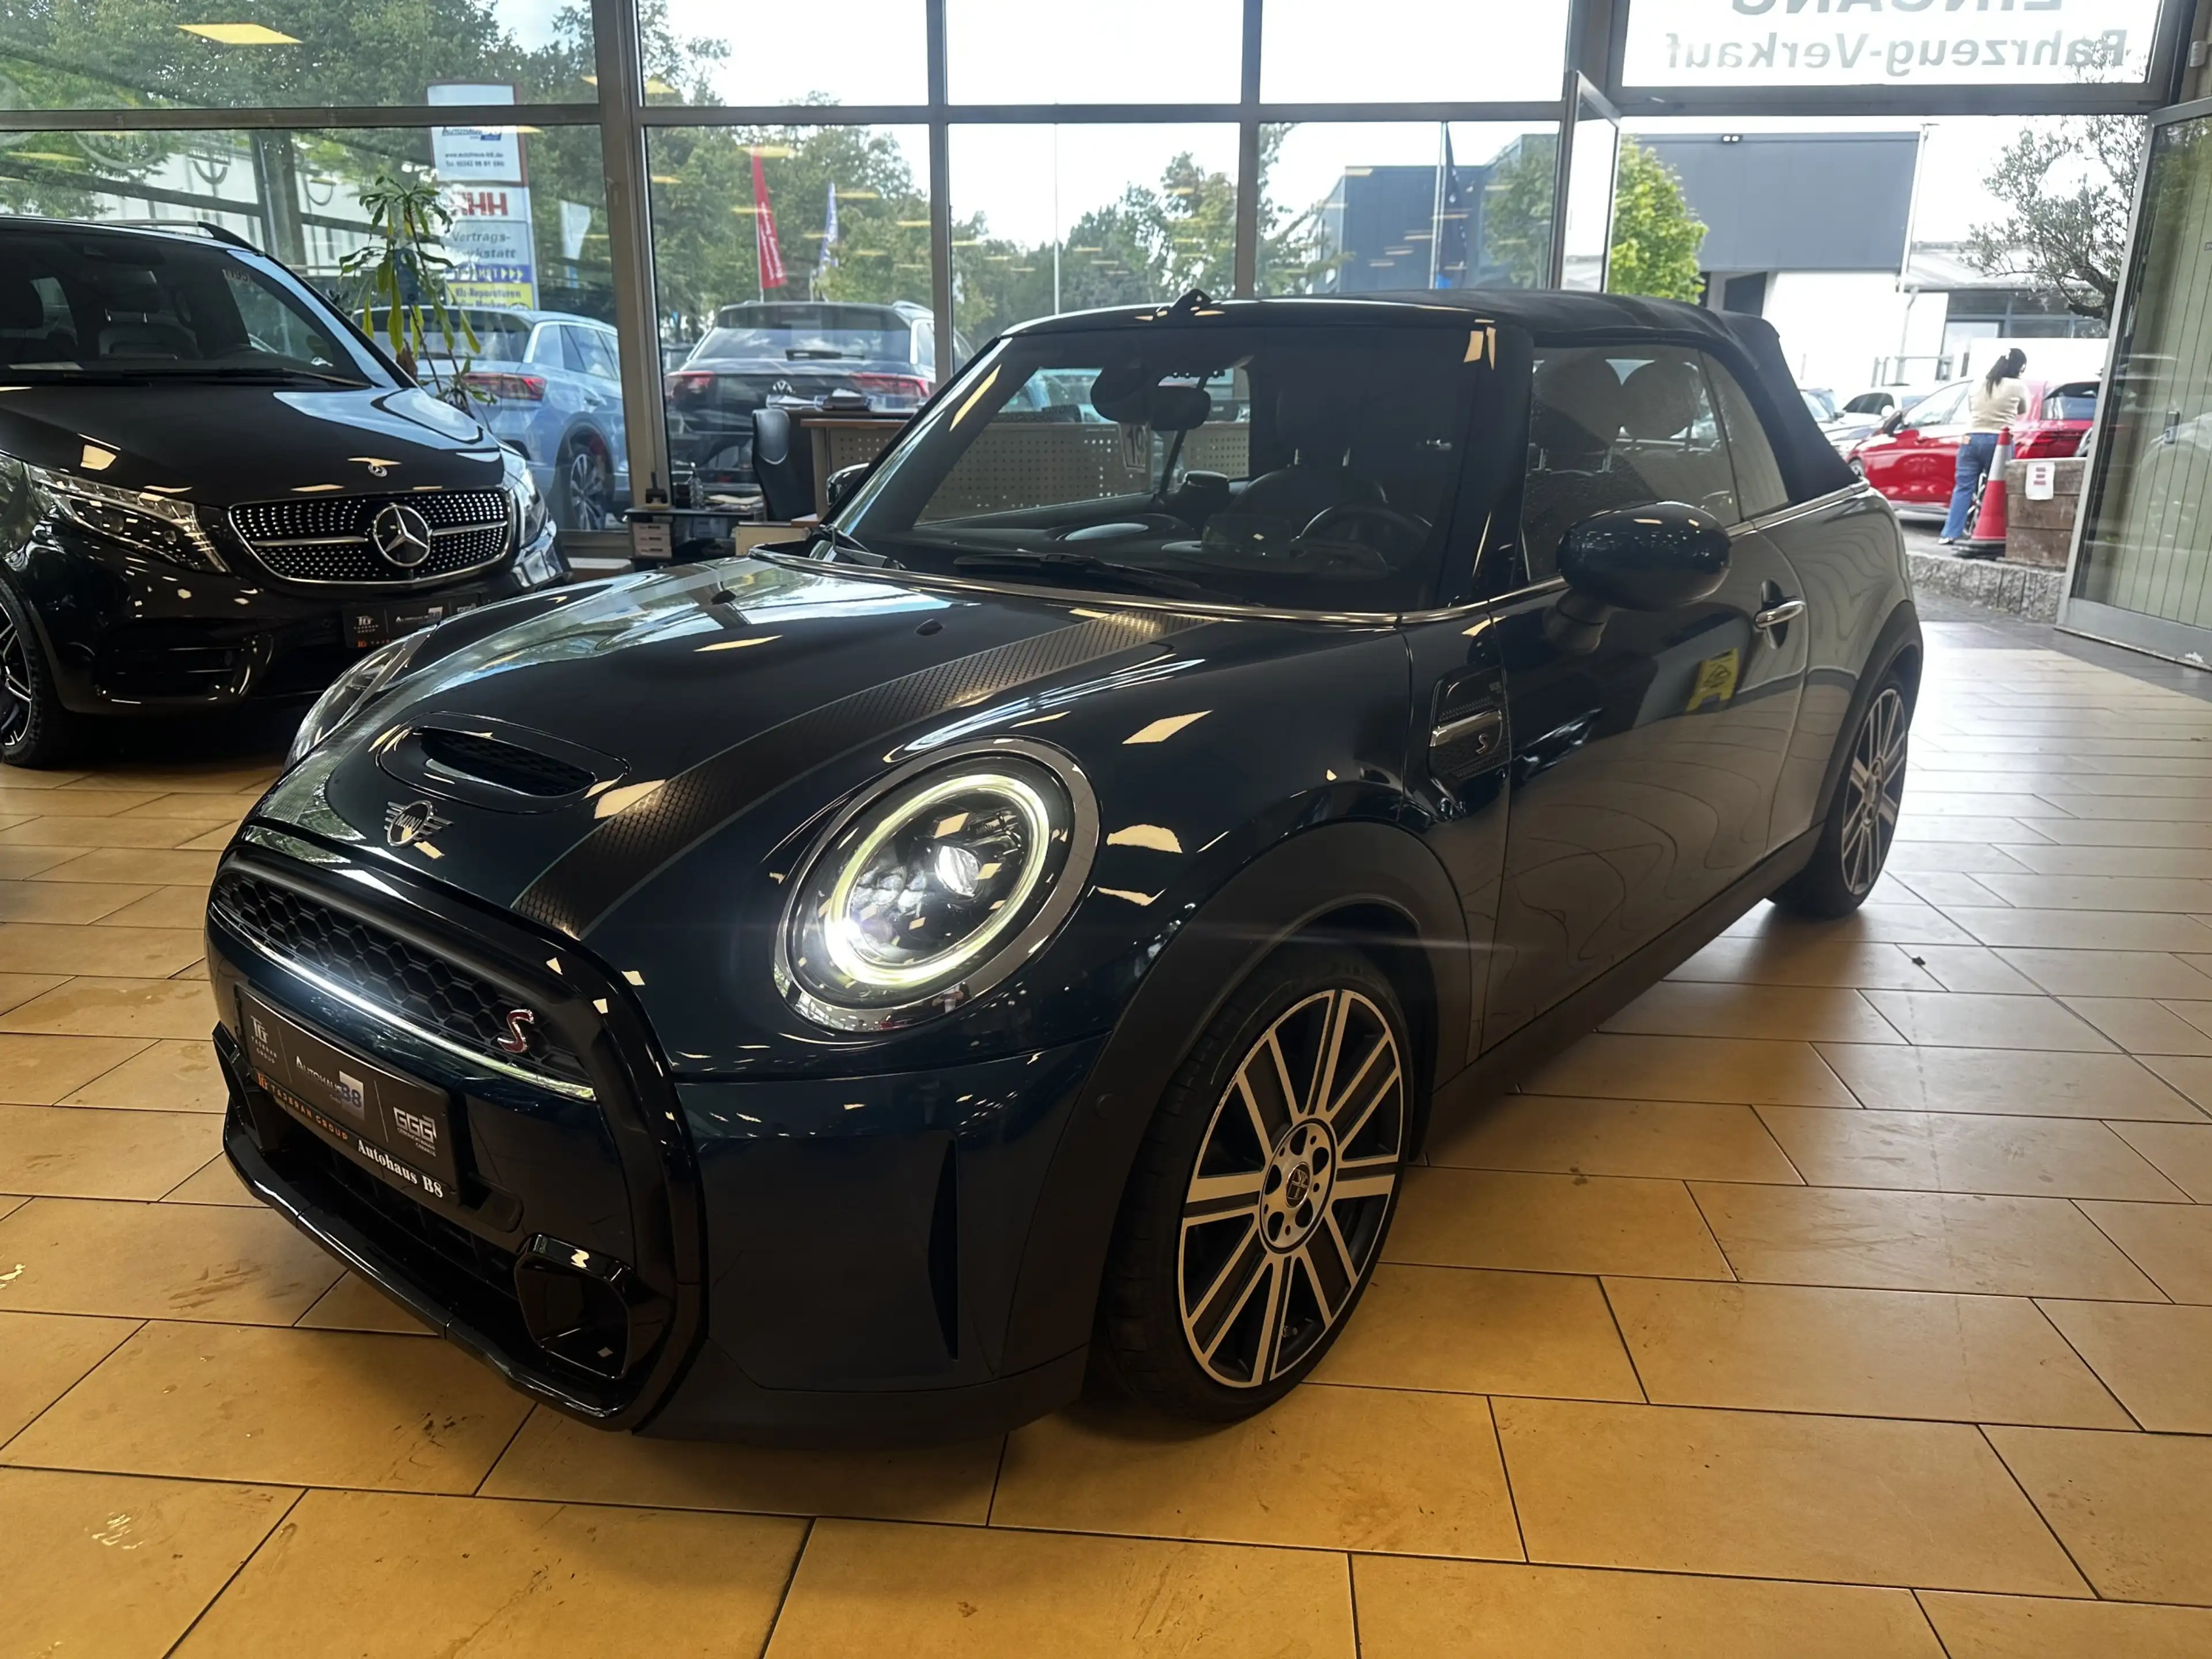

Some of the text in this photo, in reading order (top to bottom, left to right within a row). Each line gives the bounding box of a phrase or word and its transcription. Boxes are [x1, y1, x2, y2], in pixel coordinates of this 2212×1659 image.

[452, 232, 511, 244] Vertrags-
[395, 813, 422, 831] MINI
[497, 1009, 535, 1053] S
[358, 1139, 444, 1198] Autohaus B8
